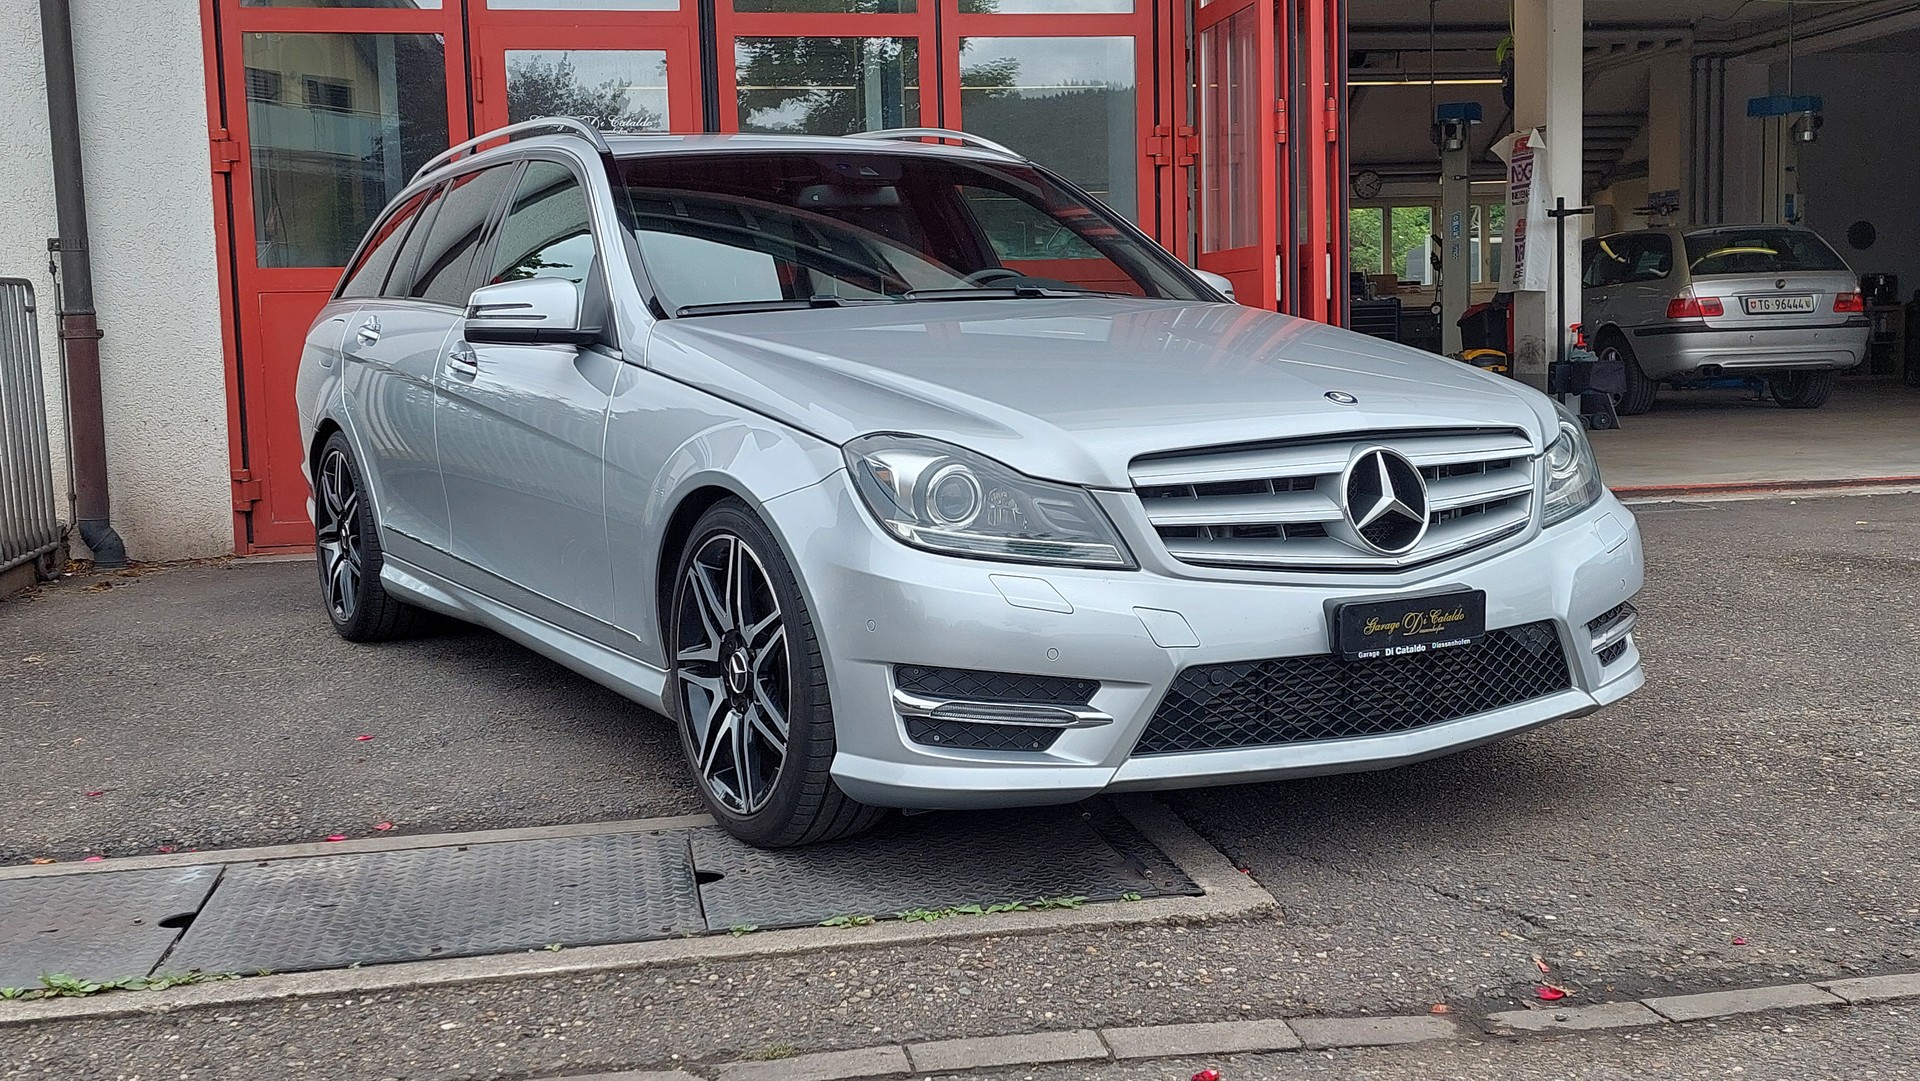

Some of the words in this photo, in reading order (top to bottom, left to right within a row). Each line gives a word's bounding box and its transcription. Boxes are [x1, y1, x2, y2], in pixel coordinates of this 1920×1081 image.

[608, 114, 653, 128] Cataldo
[1363, 616, 1400, 635] Garage
[1401, 611, 1429, 636] Di
[1429, 607, 1465, 624] Cataldo
[1358, 650, 1380, 658] Garage
[1385, 648, 1394, 656] Di
[1395, 644, 1426, 655] Cataldo
[1431, 638, 1471, 649] Diessenhofen
